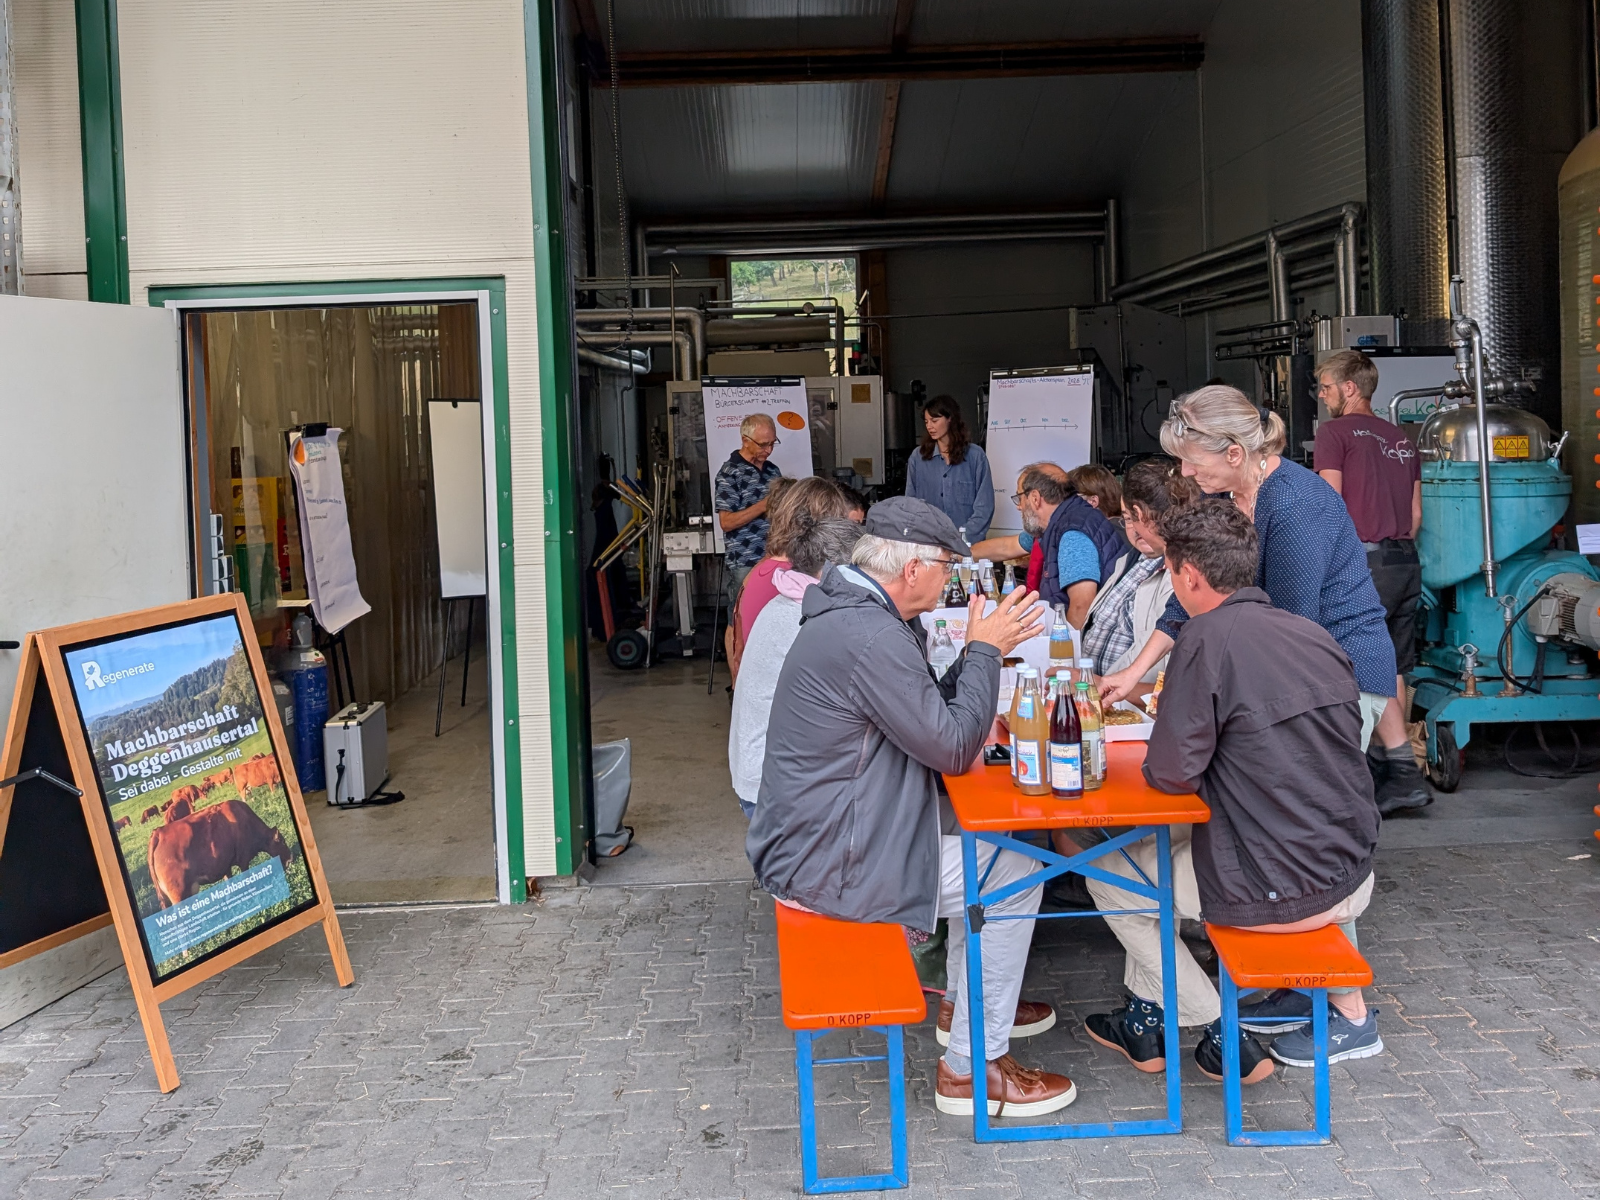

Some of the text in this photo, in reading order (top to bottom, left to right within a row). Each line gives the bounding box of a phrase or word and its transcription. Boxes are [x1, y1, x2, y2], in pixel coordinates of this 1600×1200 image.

[710, 387, 782, 398] MACHBARSCHAFT
[82, 660, 154, 690] Regenerate
[105, 704, 240, 760] Machbarschaft
[111, 717, 259, 782] Deggenhausertal
[118, 787, 138, 801] Sei
[140, 772, 172, 795] dabei
[180, 755, 224, 778] Gestalte
[226, 748, 242, 762] mit
[156, 864, 273, 927] Was ist eine Machbarschaft?
[1284, 976, 1327, 987] O.KOPP
[828, 1013, 871, 1026] O.KOPP
